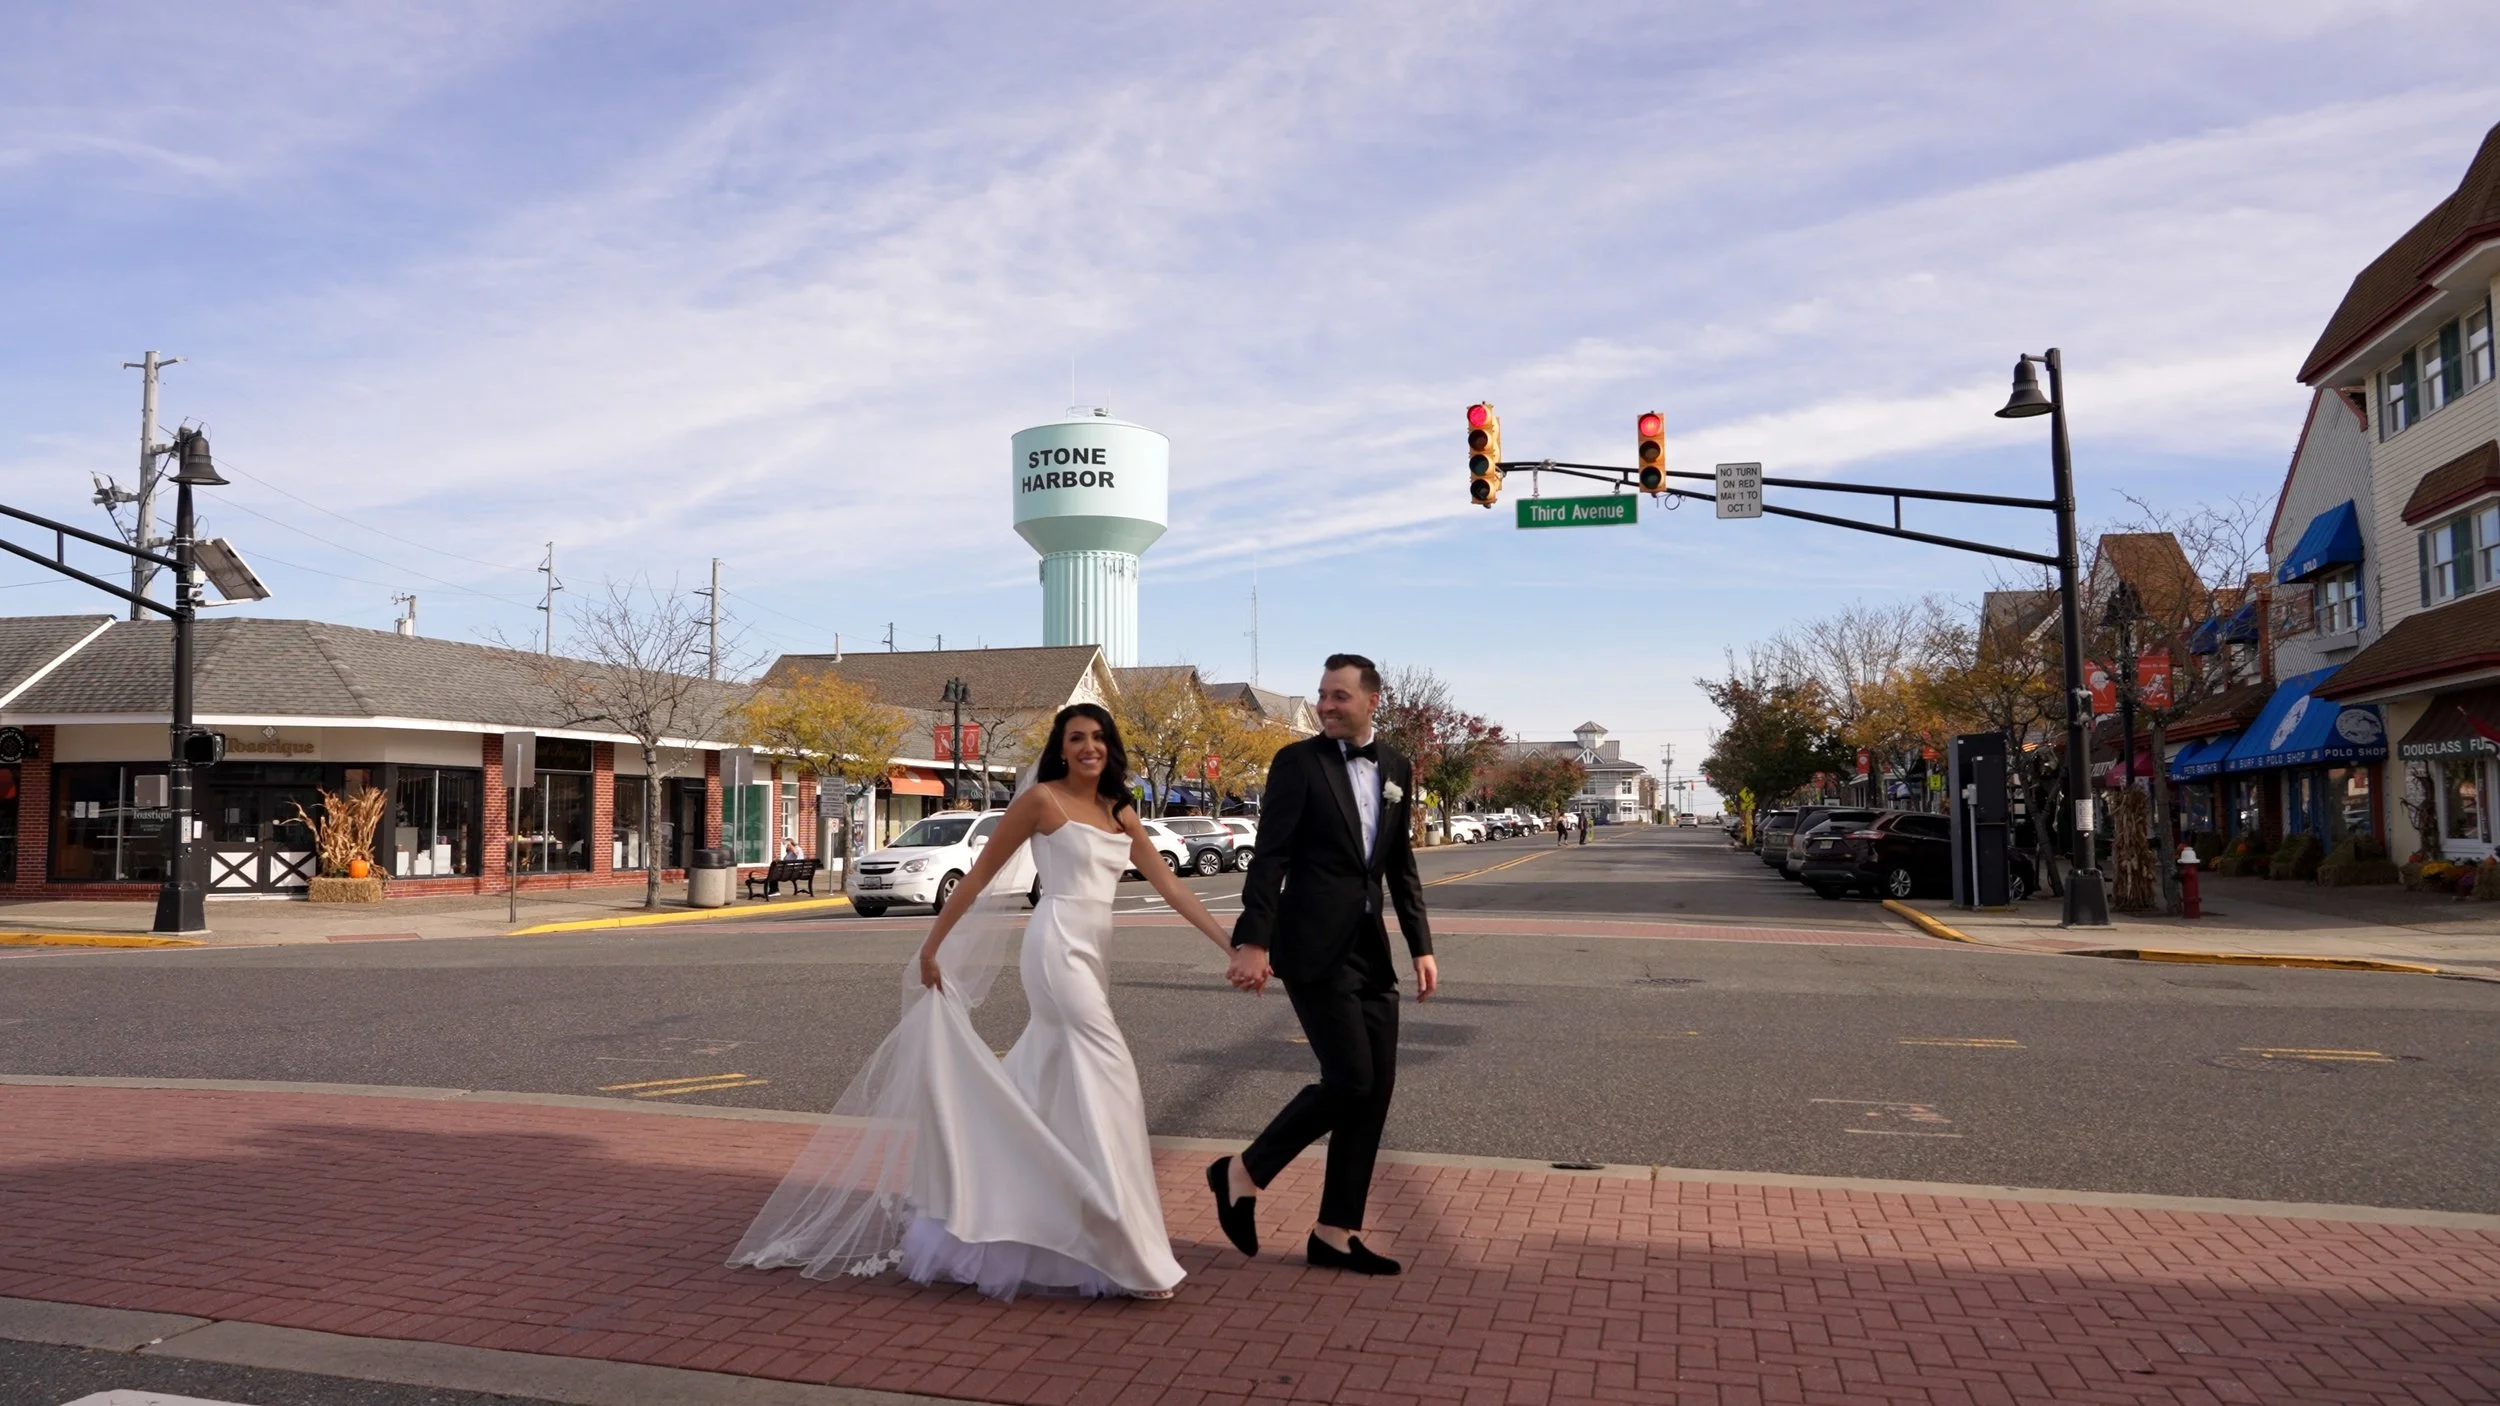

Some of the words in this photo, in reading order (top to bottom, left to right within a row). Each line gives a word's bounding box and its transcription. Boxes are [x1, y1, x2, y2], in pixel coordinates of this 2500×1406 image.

[1029, 448, 1106, 468] STONE
[1720, 468, 1732, 477] NO
[1736, 467, 1757, 476] TURN
[1022, 470, 1115, 493] HARBOR
[1723, 480, 1735, 489] ON
[1738, 479, 1755, 488] RED
[1720, 492, 1735, 500] MAY
[1747, 490, 1758, 500] TO
[1530, 505, 1566, 521] Third
[1572, 504, 1625, 519] Avenue
[1727, 503, 1744, 512] OCT
[2303, 558, 2318, 573] POLO
[225, 737, 315, 757] Toastique
[2324, 748, 2353, 757] POLO
[2358, 747, 2387, 756] SHOP
[2403, 740, 2462, 756] DOUGLASS
[2240, 759, 2254, 768] SURF
[2266, 754, 2282, 765] POLO
[2286, 752, 2305, 762] SHOP
